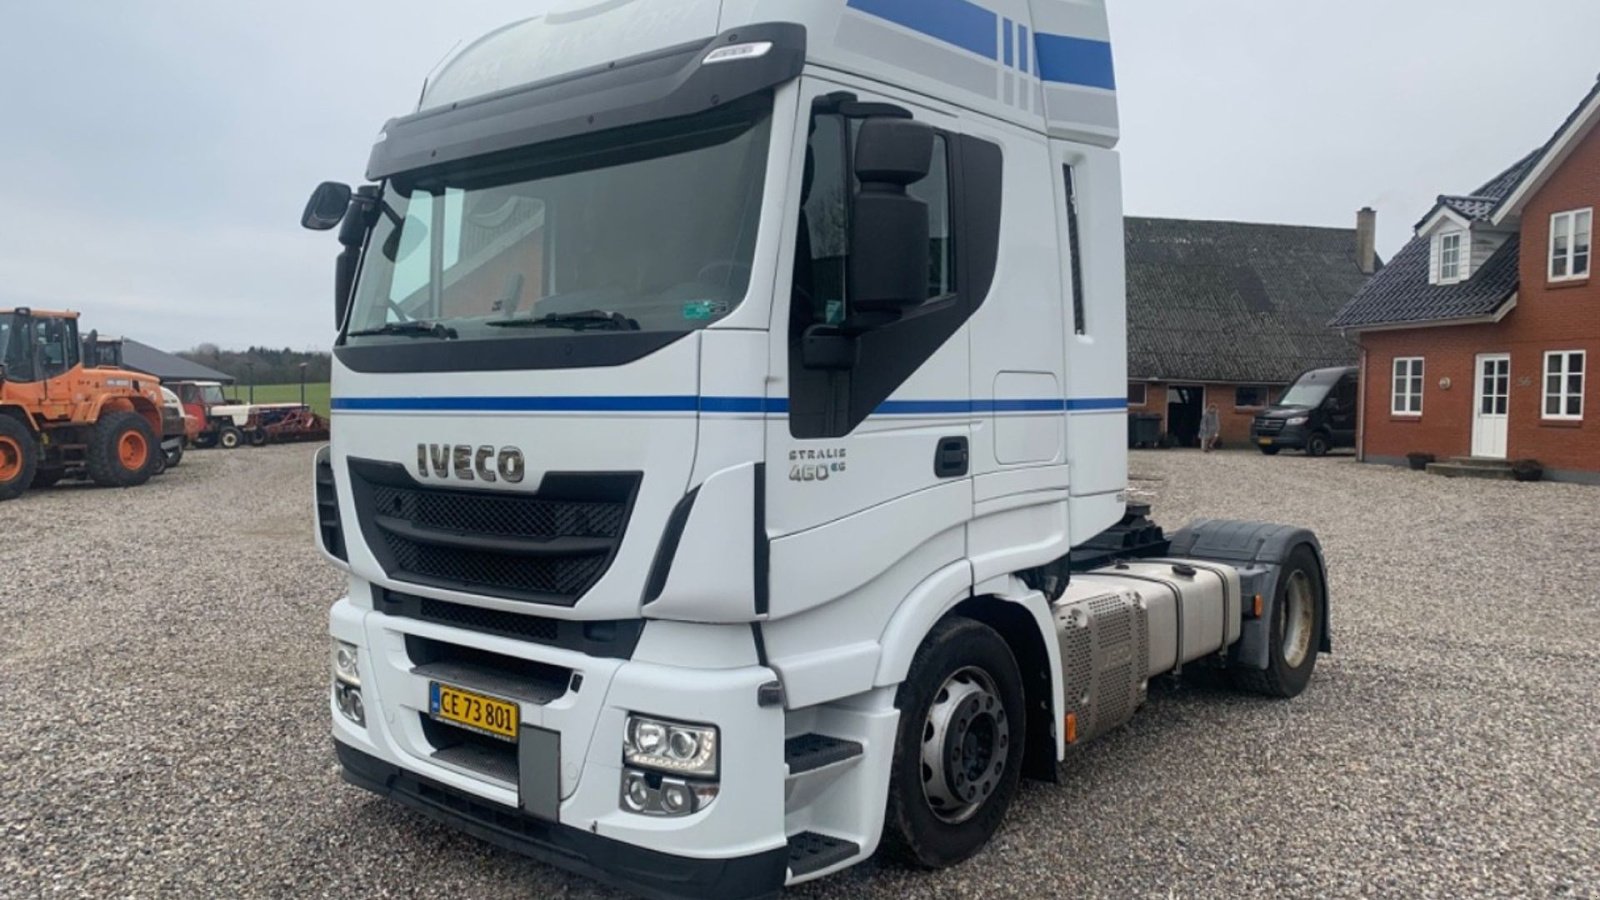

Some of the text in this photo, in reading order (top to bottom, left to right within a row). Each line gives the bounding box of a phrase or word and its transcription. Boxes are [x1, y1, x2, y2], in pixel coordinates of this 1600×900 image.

[417, 443, 525, 483] IVECO
[789, 448, 847, 460] STRALIS
[789, 463, 829, 482] 460
[441, 691, 459, 716] CE
[463, 696, 482, 722] 73
[485, 703, 513, 731] 801
